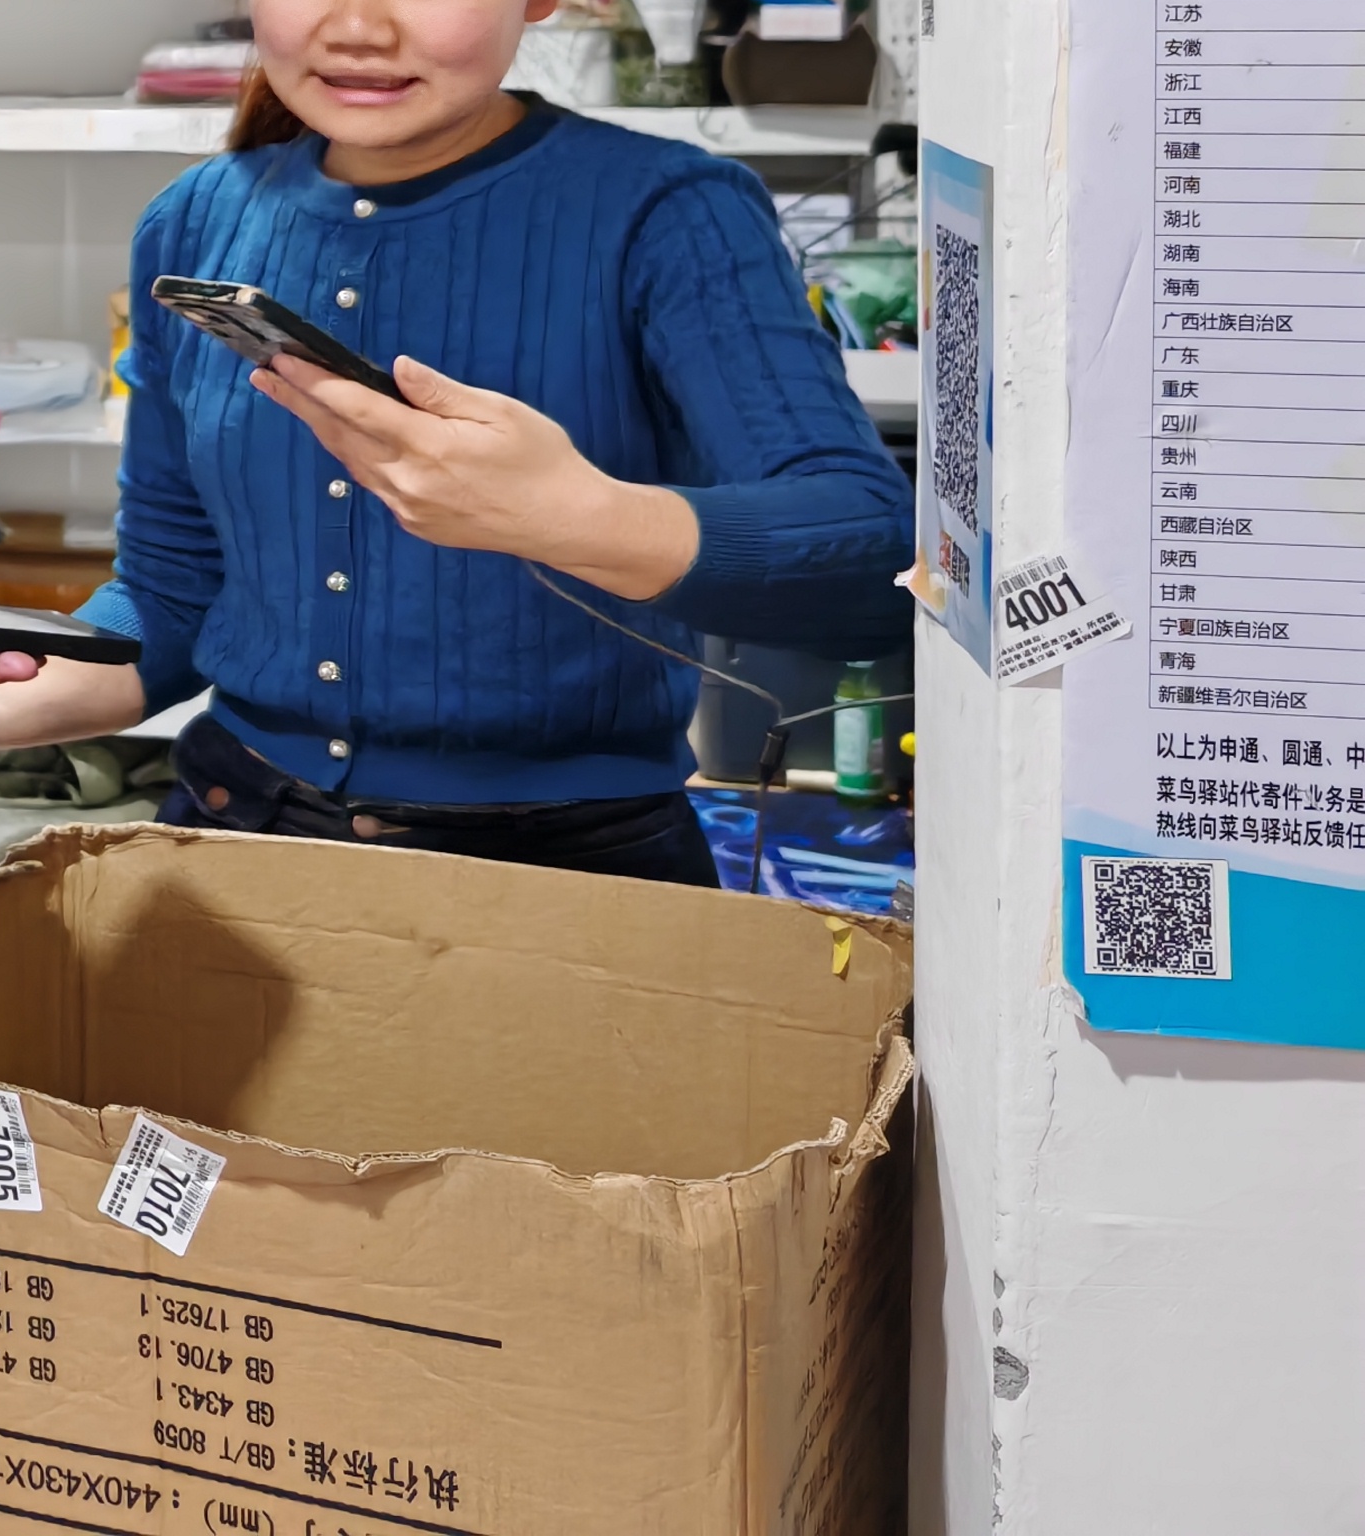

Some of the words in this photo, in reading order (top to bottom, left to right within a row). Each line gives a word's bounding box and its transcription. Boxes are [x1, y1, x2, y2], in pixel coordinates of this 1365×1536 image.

[1164, 4, 1201, 22] 江苏
[1164, 38, 1201, 56] 安徽
[1164, 73, 1201, 91] 浙江
[1164, 108, 1201, 125] 江西
[1163, 142, 1200, 160] 福建
[1163, 176, 1200, 194] 河南
[1163, 210, 1200, 228] 湖北
[1162, 244, 1199, 261] 湖南
[1162, 278, 1199, 296] 海南
[1161, 312, 1292, 332] 广西壮族自治区
[1161, 347, 1199, 364] 广东
[1161, 380, 1198, 398] 重庆
[1161, 414, 1197, 433] 四川
[1160, 447, 1196, 465] 贵州
[1160, 482, 1196, 500] 云南
[1160, 516, 1253, 535] 西藏自治区
[1159, 549, 1197, 568] 陕西
[1005, 572, 1086, 631] 4001
[1159, 584, 1196, 603] 甘肃
[1158, 618, 1289, 640] 宁夏回族自治区
[1158, 651, 1195, 671] 青海
[1157, 685, 1307, 709] 新疆维吾尔自治区
[137, 1163, 190, 1237] 7010
[27, 1276, 53, 1301] GB
[139, 1292, 230, 1332] 17625.1
[28, 1316, 55, 1342] GB
[244, 1315, 273, 1342] GB
[138, 1333, 232, 1375] 4706.13
[30, 1357, 56, 1382] GB
[245, 1357, 274, 1384] GB
[155, 1378, 233, 1417] 4343.1
[247, 1400, 274, 1427] GB
[153, 1424, 206, 1455] 8059
[216, 1434, 275, 1470] GB/T
